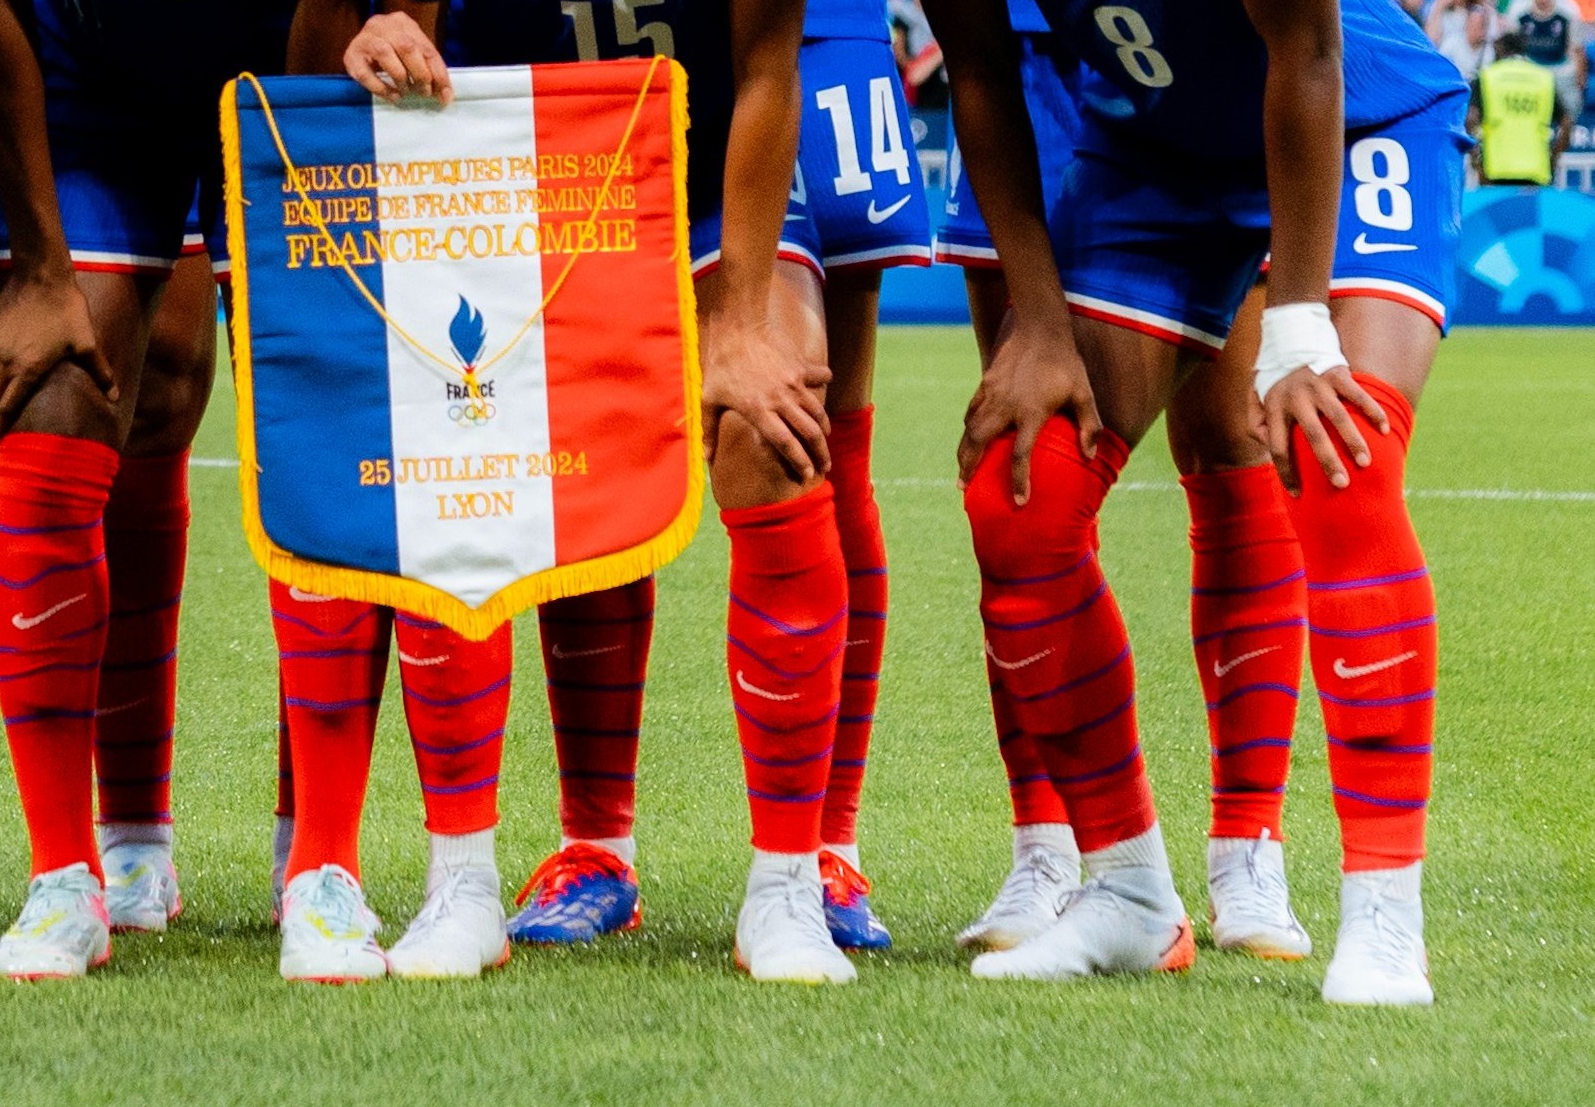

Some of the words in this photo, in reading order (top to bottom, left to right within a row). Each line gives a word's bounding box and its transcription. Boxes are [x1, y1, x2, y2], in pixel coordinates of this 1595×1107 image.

[1093, 5, 1174, 88] 8
[815, 77, 911, 196] 14
[282, 165, 345, 192] JEUX
[346, 157, 504, 189] OLYMPIQUES
[507, 154, 580, 181] PARIS
[1350, 137, 1414, 232] 8
[282, 197, 373, 226] EQUIPE
[376, 196, 410, 221] DE
[413, 190, 512, 219] FRANCE
[285, 219, 637, 269] FRANCE-COLOMBIE
[446, 380, 496, 401] FRACE
[359, 459, 392, 487] 25
[396, 453, 520, 485] JUILLET
[526, 450, 589, 478] 2024
[436, 491, 515, 521] LYON
